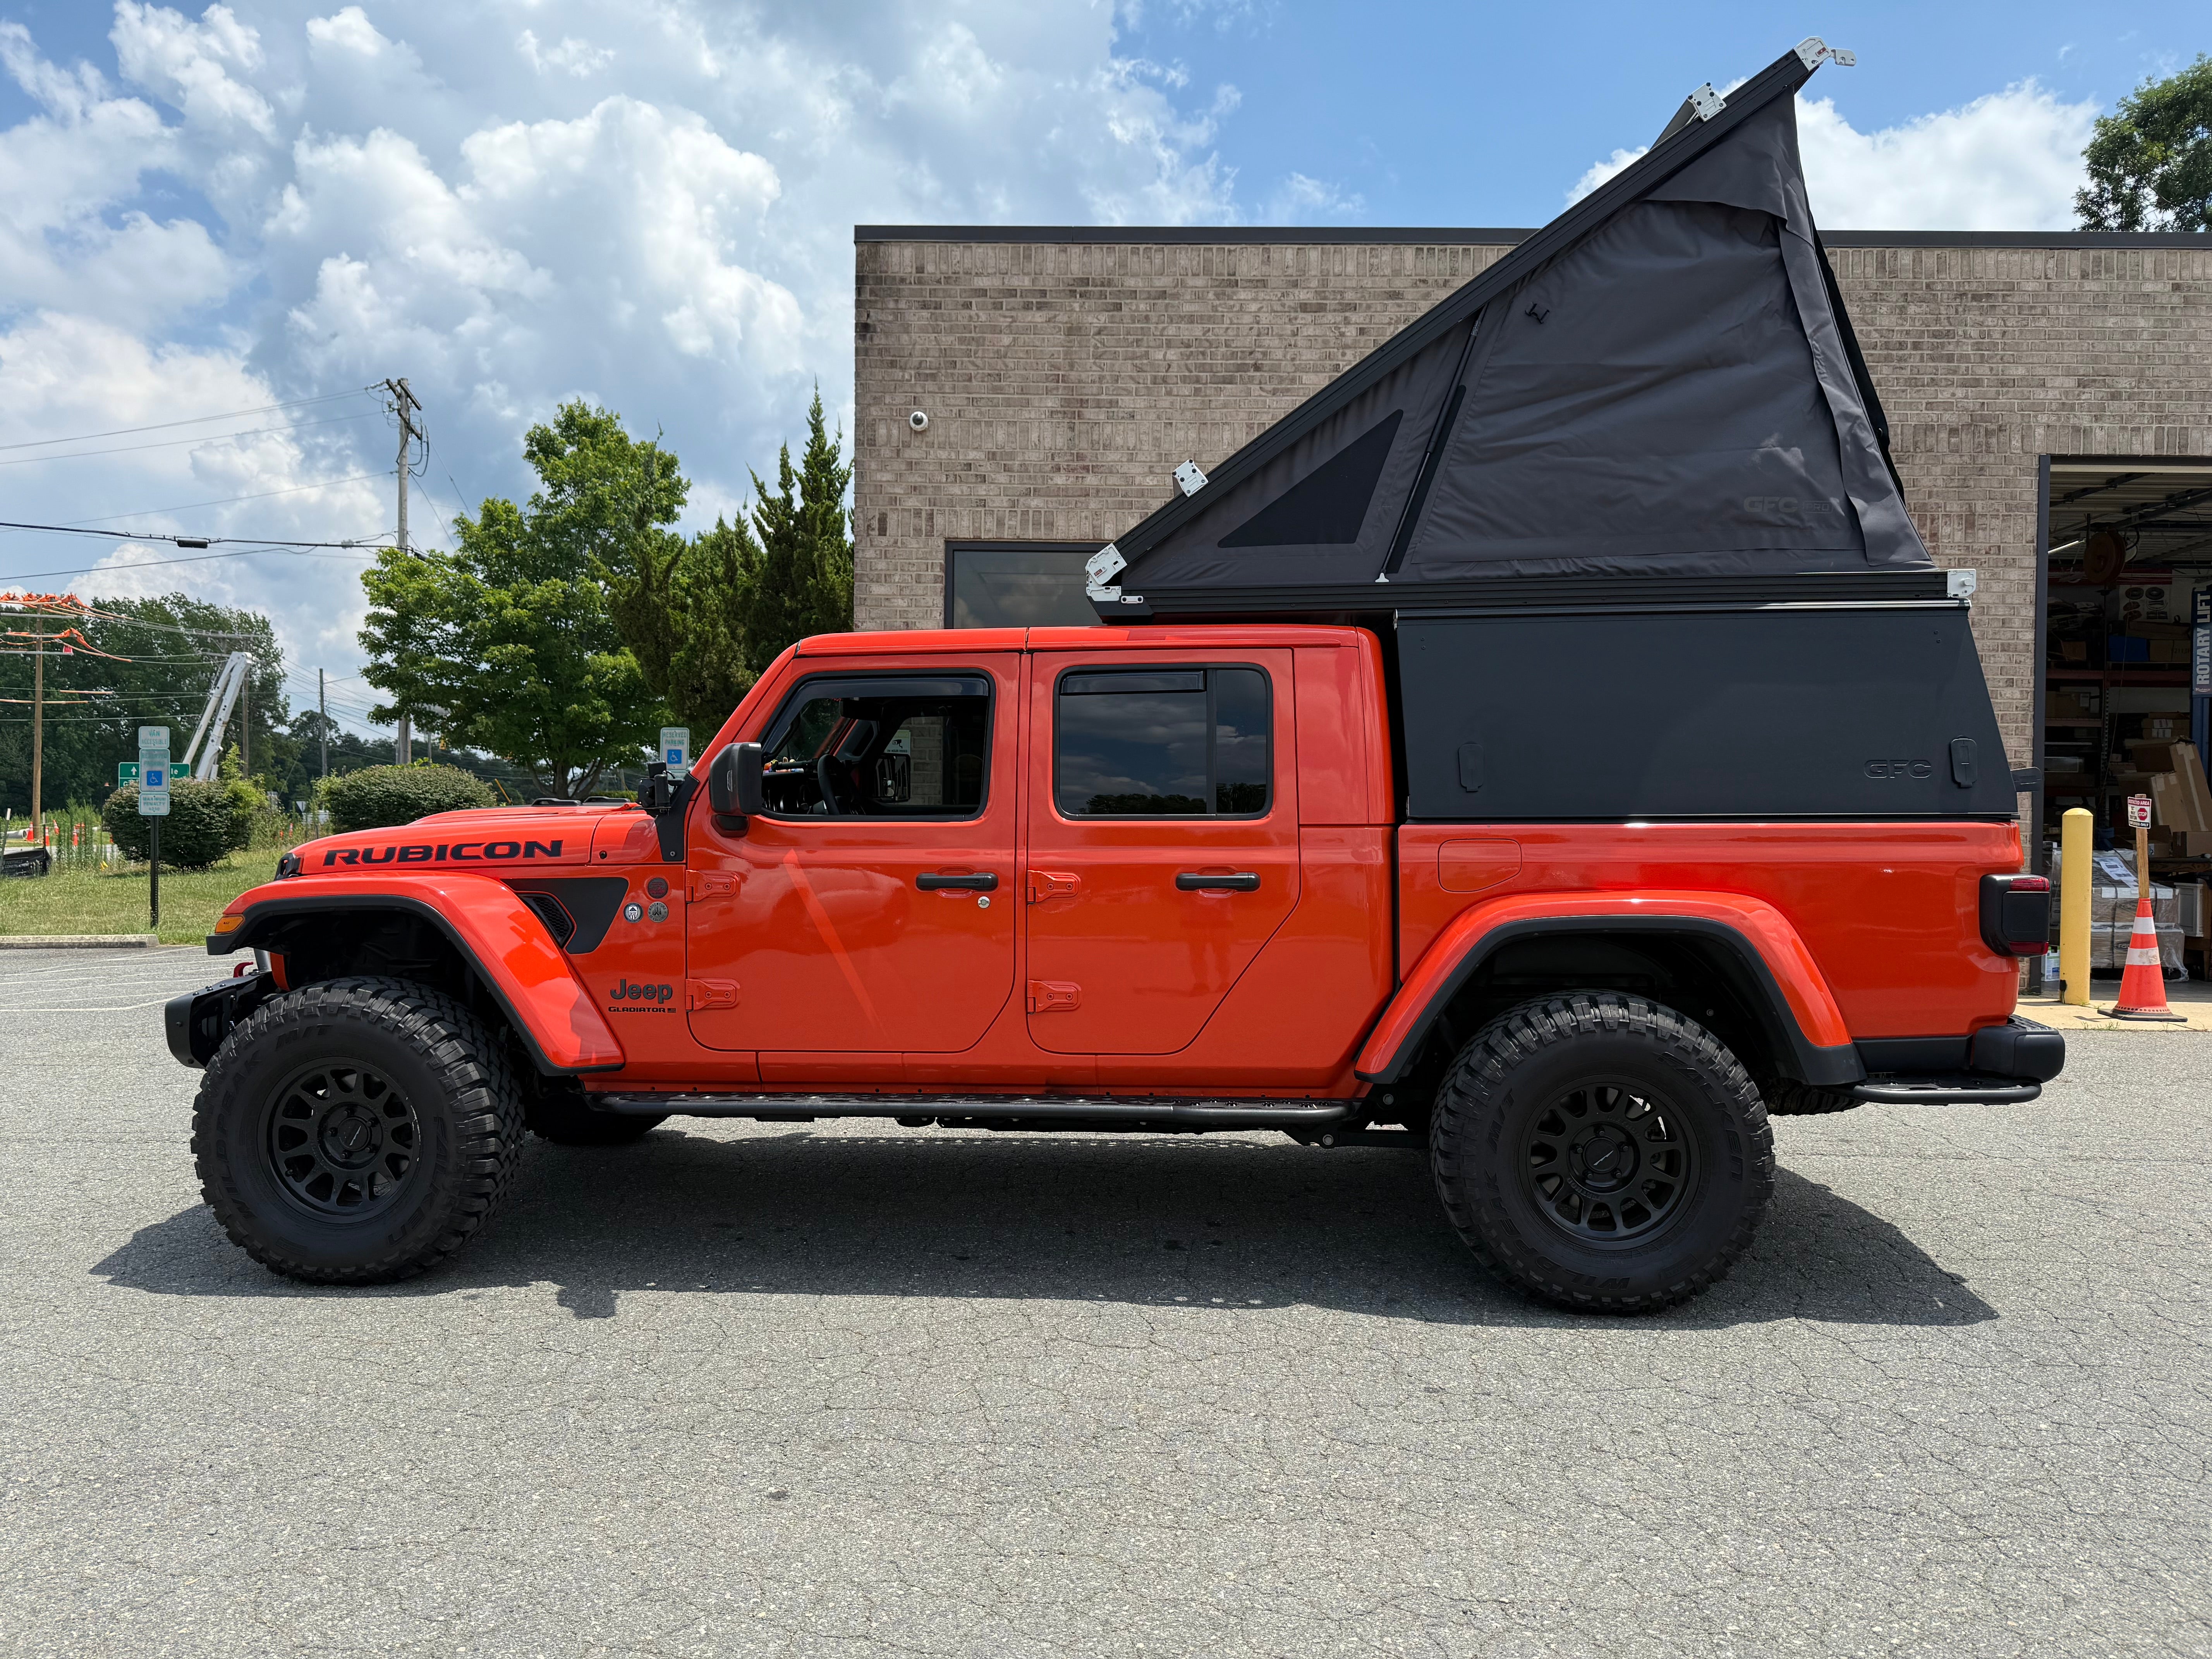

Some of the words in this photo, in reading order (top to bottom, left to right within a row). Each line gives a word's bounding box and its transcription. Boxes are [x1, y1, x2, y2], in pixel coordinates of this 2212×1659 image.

[1744, 496, 1798, 513] GFC
[2197, 594, 2210, 623] LIFT
[2197, 628, 2210, 685] ROTARY
[1864, 759, 1932, 778] GFC
[323, 840, 563, 867] RUBICON
[610, 979, 673, 1004] Jeep
[214, 1049, 263, 1222] WILDPEAK
[1484, 1166, 1632, 1292] WILDPEAK
